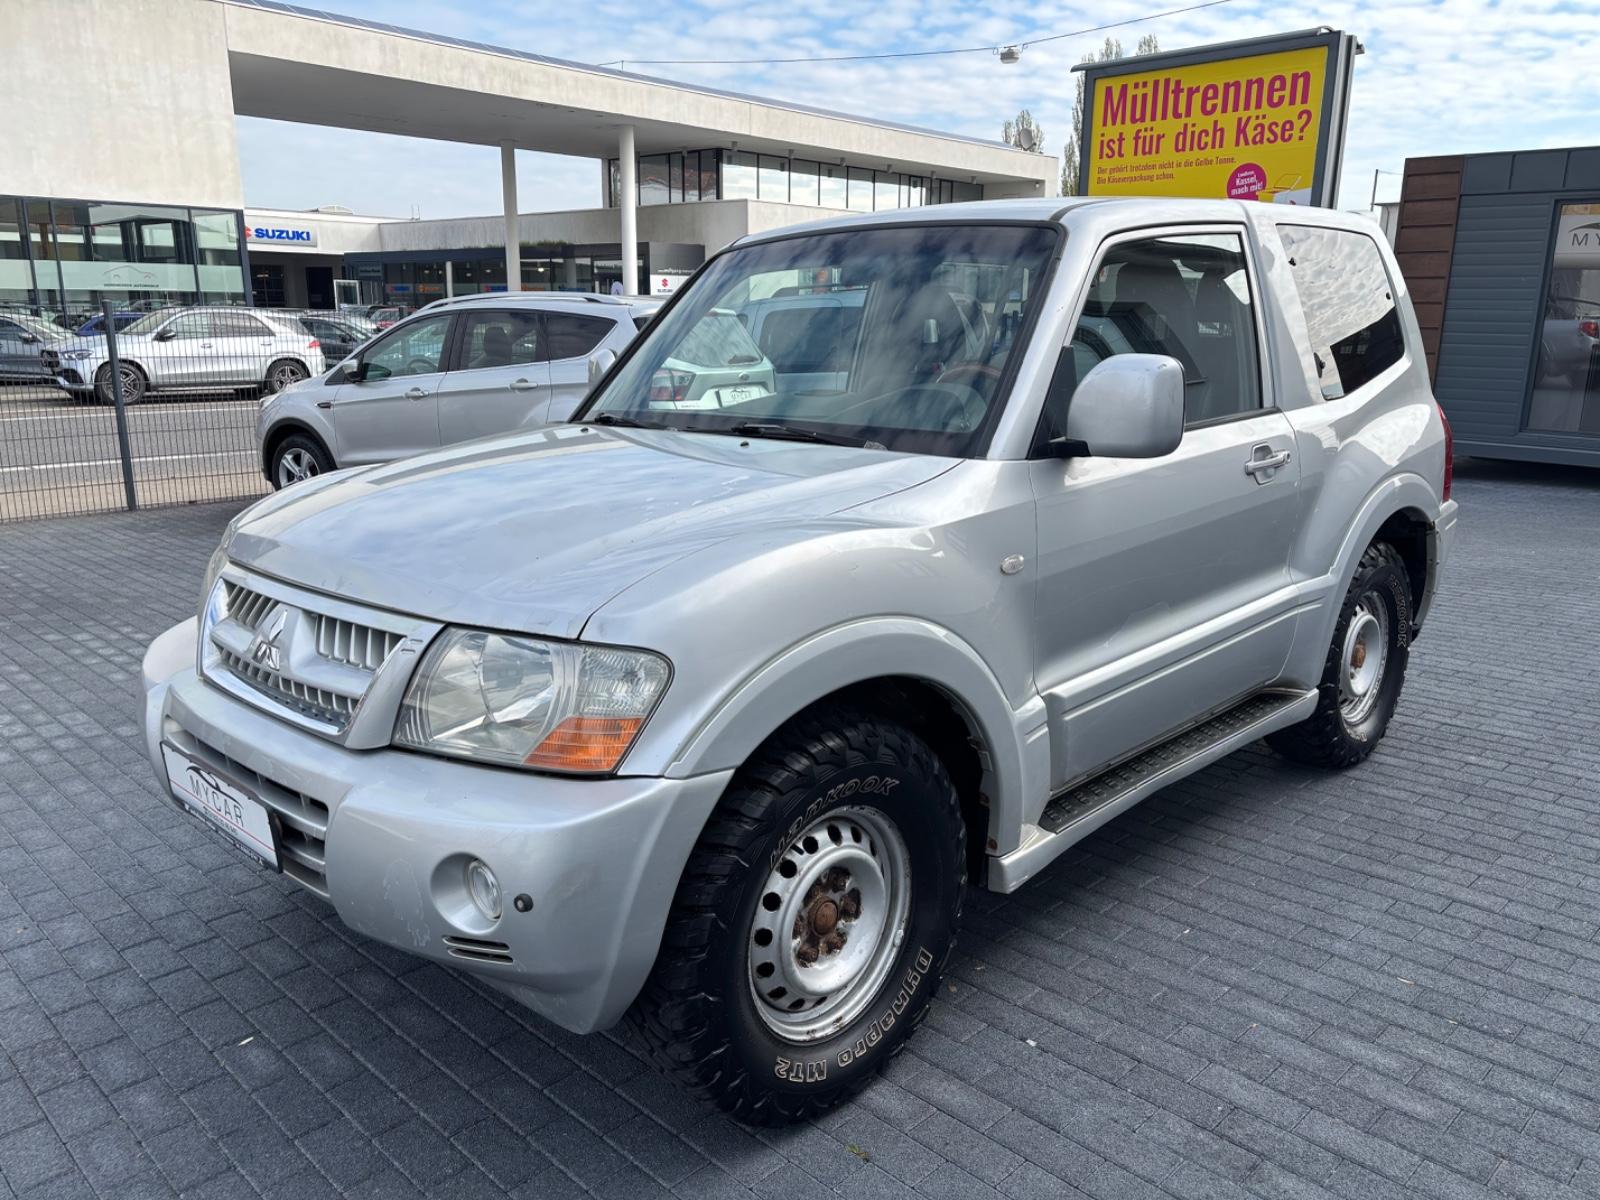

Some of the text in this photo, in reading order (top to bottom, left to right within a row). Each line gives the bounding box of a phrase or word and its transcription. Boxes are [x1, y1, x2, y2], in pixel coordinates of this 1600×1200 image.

[1102, 70, 1311, 127] Mülltrennen
[1099, 109, 1313, 159] ist für dich Käse?
[1107, 173, 1155, 184] Käseverpackung
[1156, 172, 1176, 180] schon.
[1108, 165, 1128, 175] gehört
[1130, 163, 1157, 173] trotzdem
[1158, 160, 1174, 170] nicht
[1184, 159, 1193, 167] die
[1195, 158, 1213, 167] Gelbe
[1215, 156, 1237, 165] Tonne.
[1231, 185, 1249, 196] mach
[254, 227, 311, 241] SUZUKI
[189, 775, 244, 828] MYCAR
[774, 945, 933, 1083] Dynapro MT2
